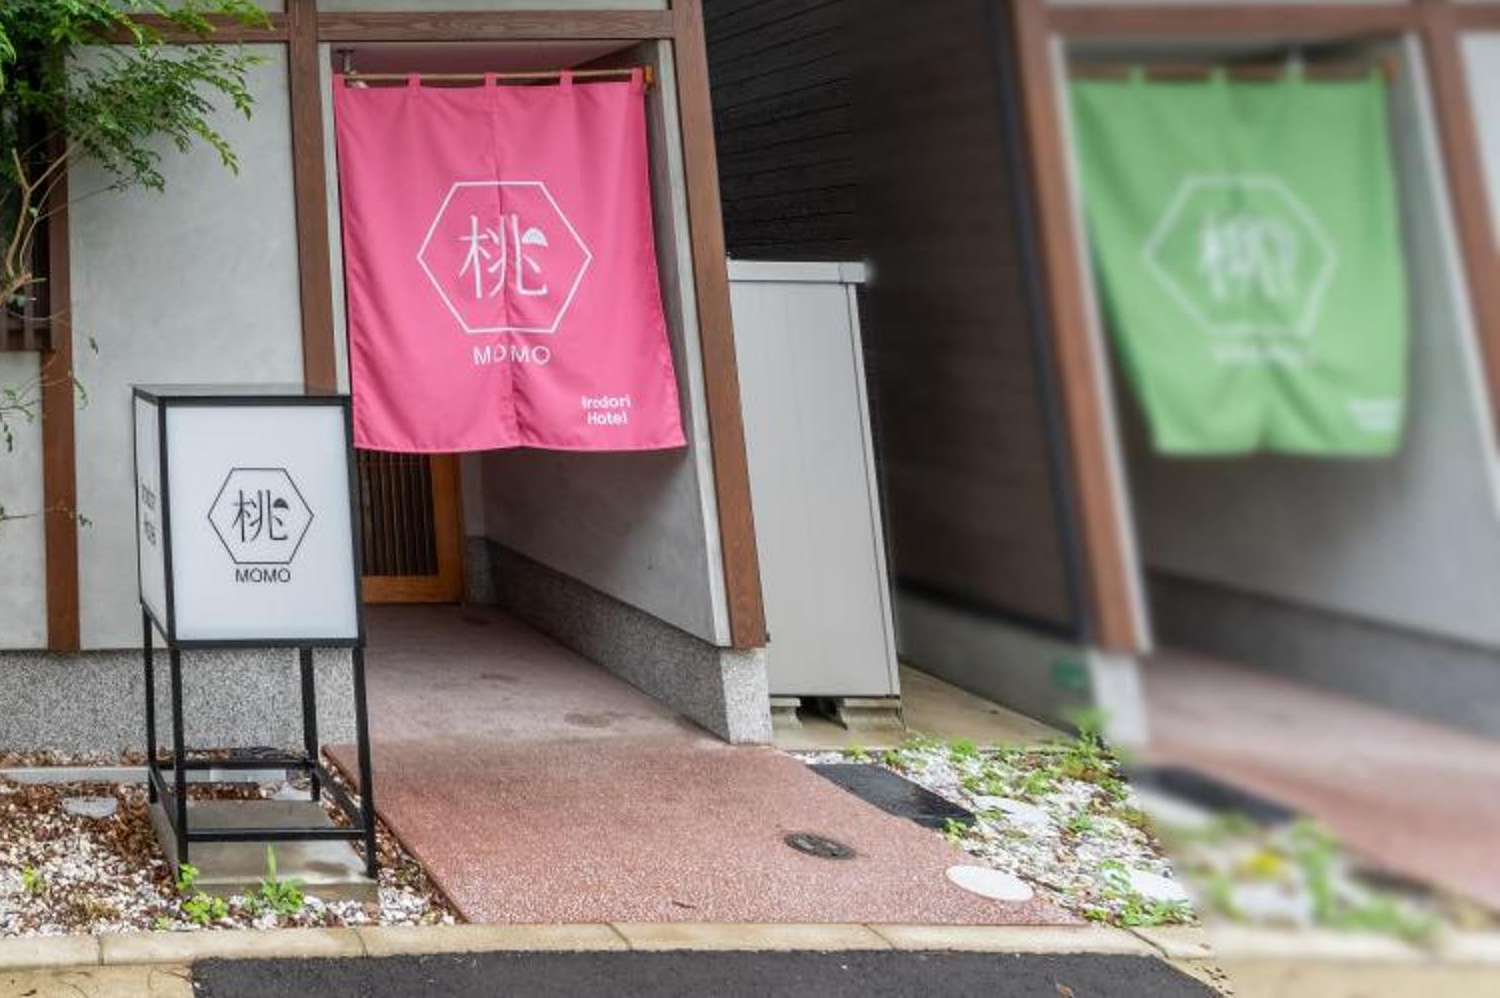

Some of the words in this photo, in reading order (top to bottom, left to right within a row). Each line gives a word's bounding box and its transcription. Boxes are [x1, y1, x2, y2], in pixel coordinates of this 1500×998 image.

[457, 214, 549, 299] 桃
[473, 344, 551, 365] MOMO
[581, 394, 631, 410] Irodori
[587, 410, 628, 426] Hotel
[232, 489, 289, 543] 桃
[235, 567, 291, 583] MOMO
